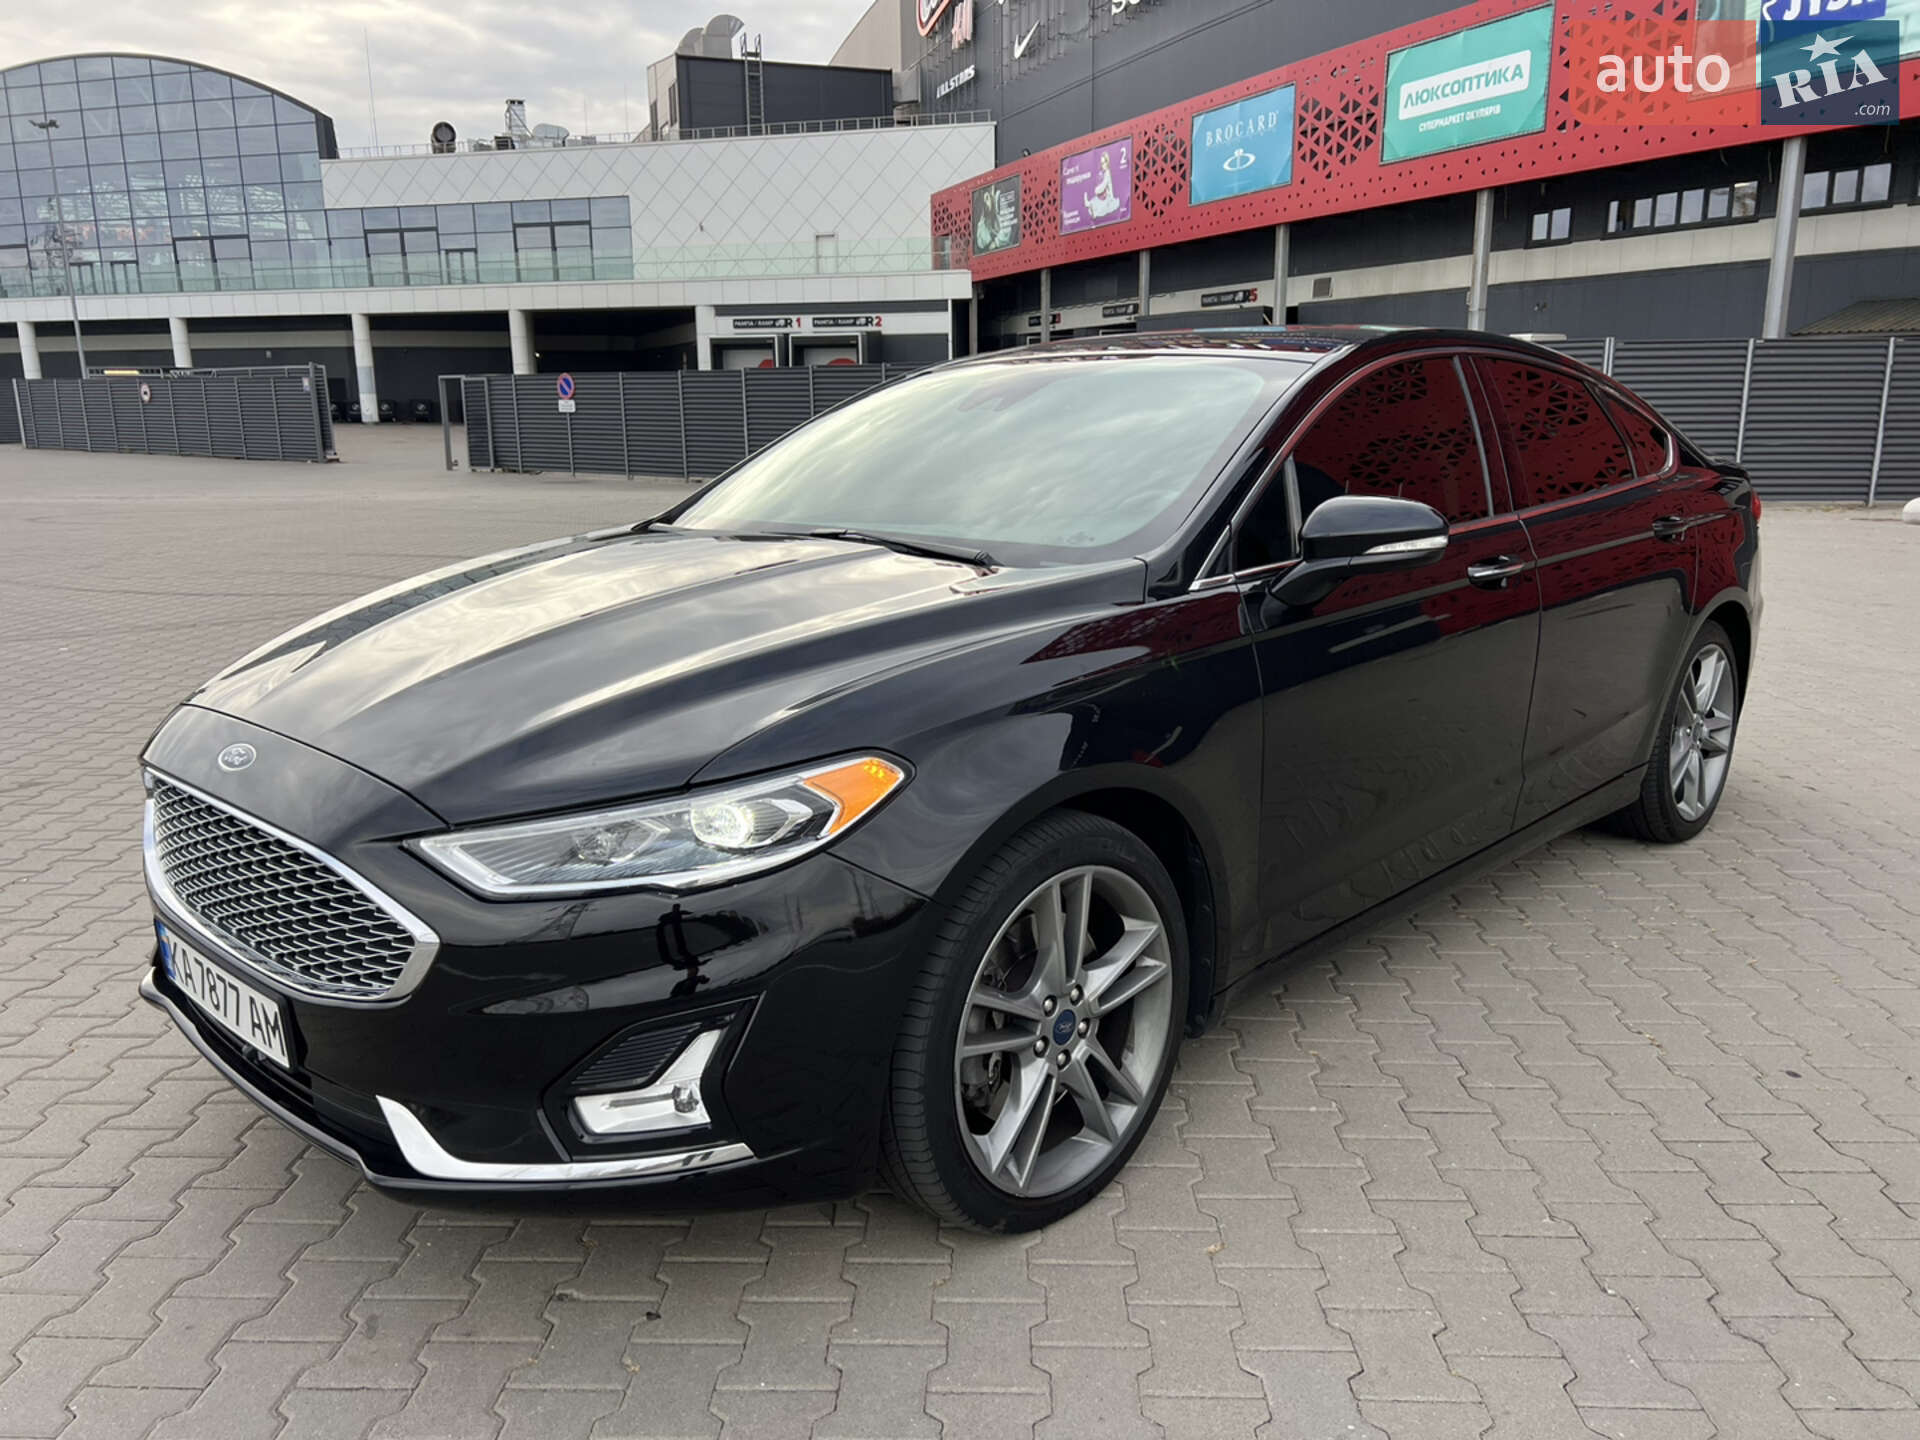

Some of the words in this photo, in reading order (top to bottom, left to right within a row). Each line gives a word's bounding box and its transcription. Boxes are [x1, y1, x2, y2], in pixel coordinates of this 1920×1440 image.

[1403, 63, 1524, 109] ЛЮКСОПТИКА
[1206, 111, 1278, 147] BROCARD
[194, 957, 240, 1027] 7877
[249, 996, 286, 1057] AM
